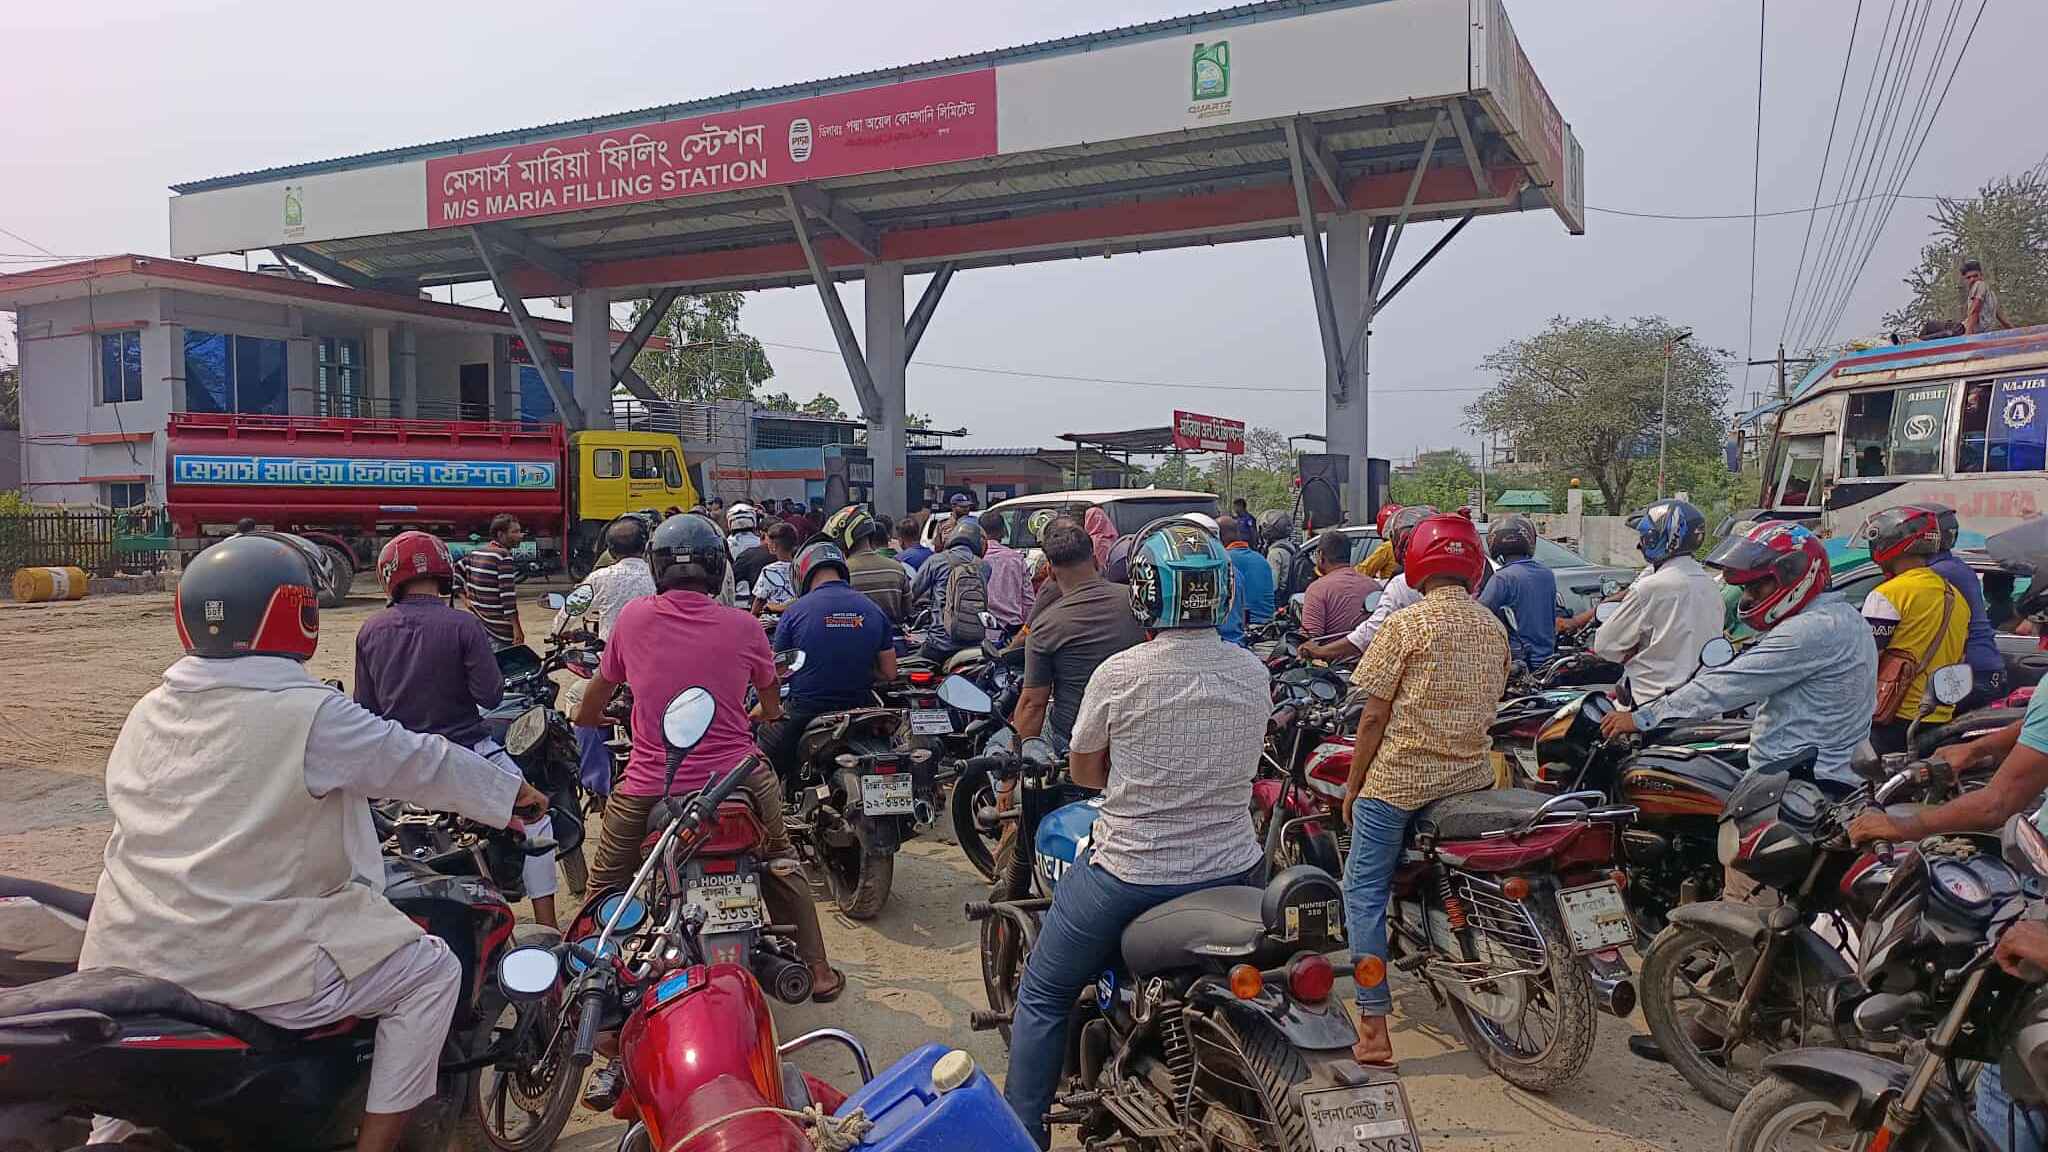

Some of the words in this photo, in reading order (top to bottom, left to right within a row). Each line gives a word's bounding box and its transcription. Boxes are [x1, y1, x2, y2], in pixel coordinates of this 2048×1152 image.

[846, 118, 863, 135] পদ্মা
[864, 114, 893, 131] অয়েল
[936, 101, 976, 121] লিমিটেড
[443, 152, 513, 197] মেসার্স
[517, 147, 591, 185] মারিয়া
[597, 133, 673, 175] ফিলিং
[681, 122, 766, 162] স্টেশন
[443, 199, 480, 221] M/S
[486, 188, 557, 215] MARIA
[562, 174, 653, 205] FILLING
[660, 158, 768, 192] STATION
[181, 457, 259, 481] মেসার্স
[264, 460, 345, 484] মারিয়া
[350, 461, 425, 483] ফিলিং
[430, 463, 512, 484] স্টেশন
[701, 875, 742, 887] HONDA
